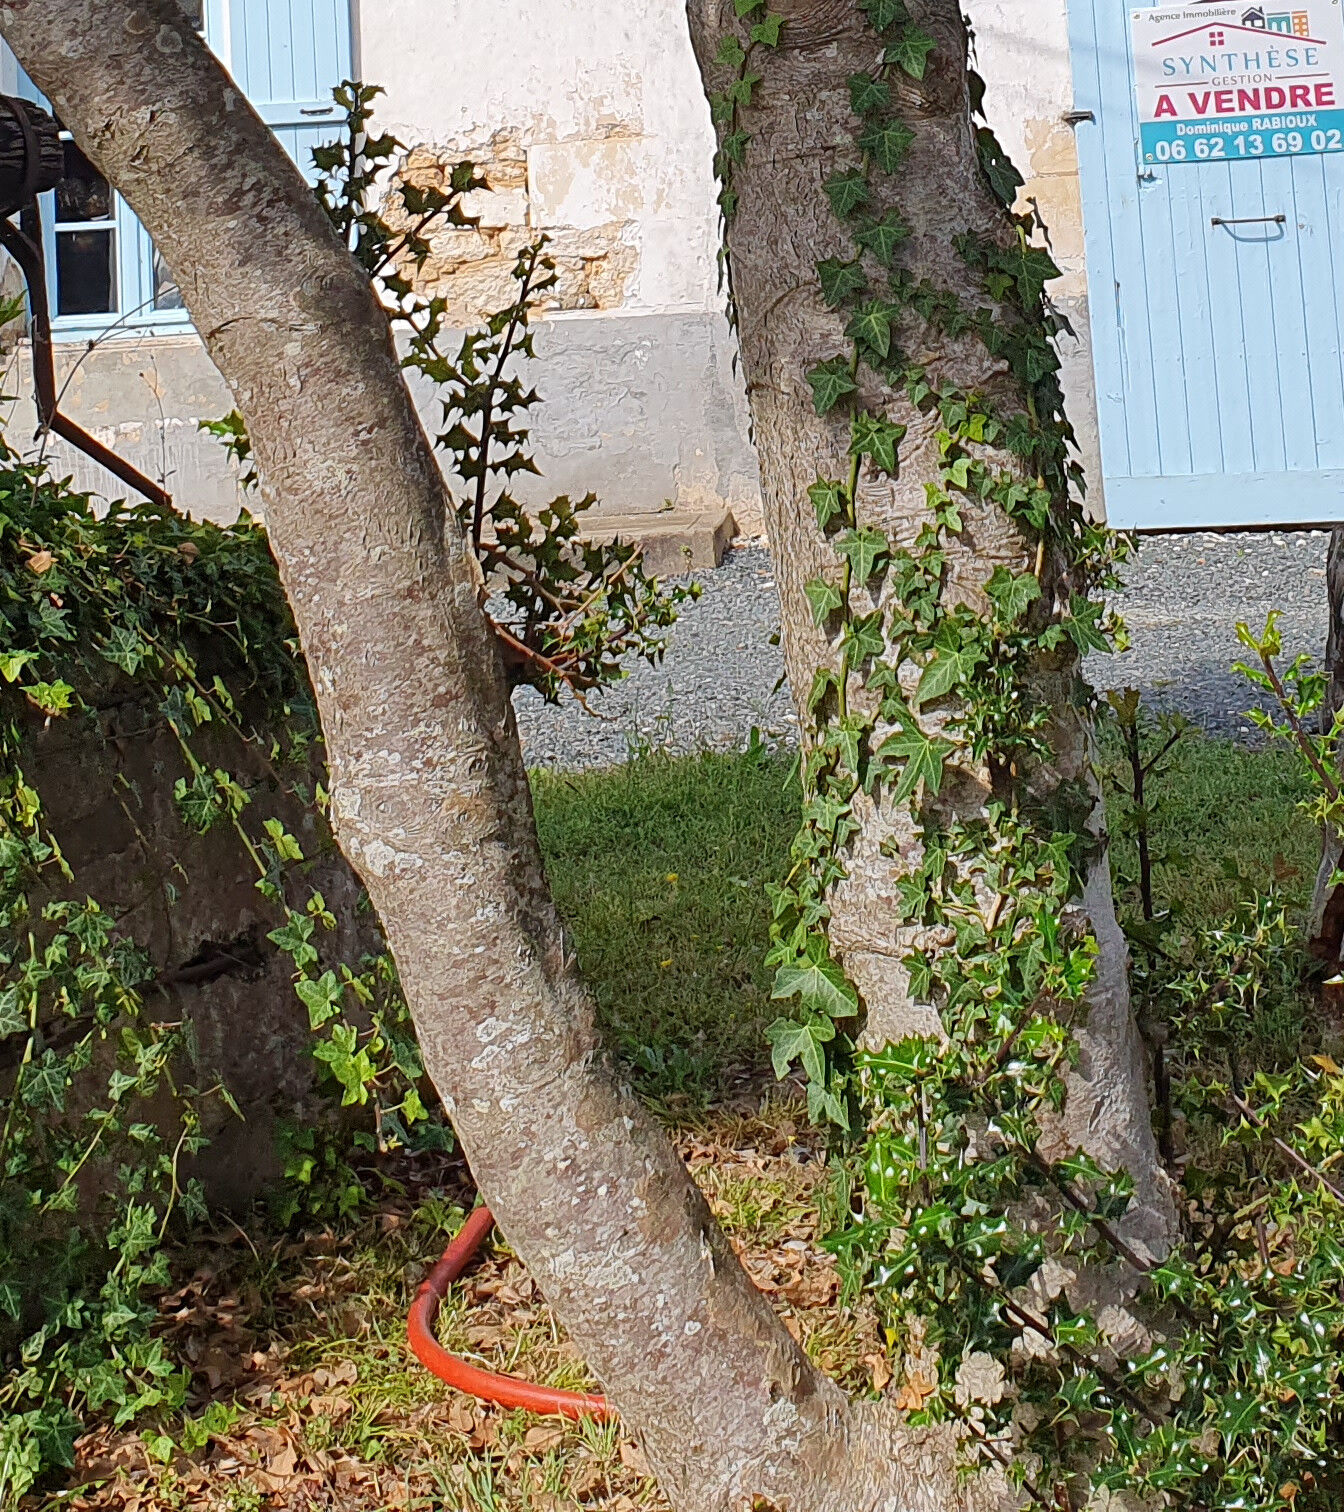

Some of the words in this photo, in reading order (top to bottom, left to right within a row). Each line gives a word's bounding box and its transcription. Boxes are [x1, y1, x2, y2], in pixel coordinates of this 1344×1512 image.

[1148, 12, 1181, 23] Agence
[1182, 8, 1237, 19] Immobilière
[1162, 45, 1319, 76] SYNTHÈSE
[1212, 73, 1273, 87] GESTION
[1153, 94, 1178, 118] A
[1187, 82, 1336, 115] VENDRE
[1176, 121, 1249, 136] Dominique
[1252, 114, 1318, 131] RABIOUX
[1155, 140, 1187, 161] 06
[1194, 137, 1226, 158] 62
[1234, 134, 1264, 155] 13
[1272, 131, 1303, 152] 69
[1310, 129, 1343, 150] 02
